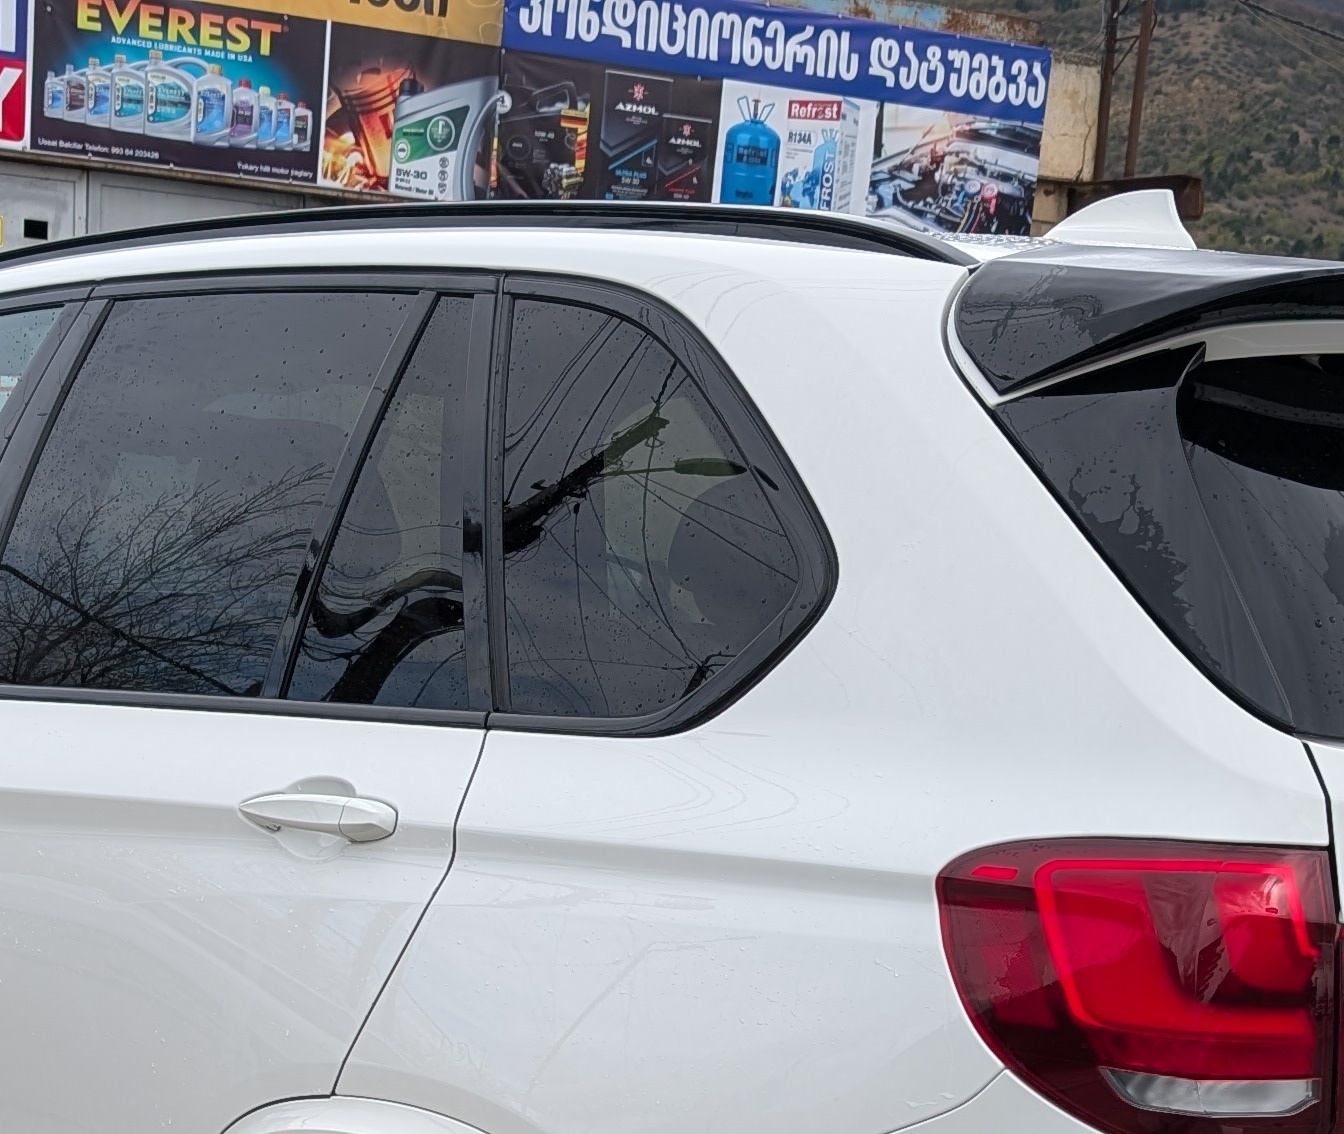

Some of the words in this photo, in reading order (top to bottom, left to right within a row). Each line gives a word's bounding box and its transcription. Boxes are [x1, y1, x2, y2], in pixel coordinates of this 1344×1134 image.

[77, 0, 282, 56] EVEREST
[111, 36, 152, 49] ADVANCED
[154, 42, 202, 56] LUBRICANTS
[205, 49, 226, 60] MADE
[227, 52, 236, 61] IN
[237, 53, 253, 63] USA
[519, 0, 859, 81] კონდიციონერის
[869, 36, 1045, 108] დატუმბვა
[615, 101, 659, 115] AZMOL
[788, 131, 812, 145] R134A
